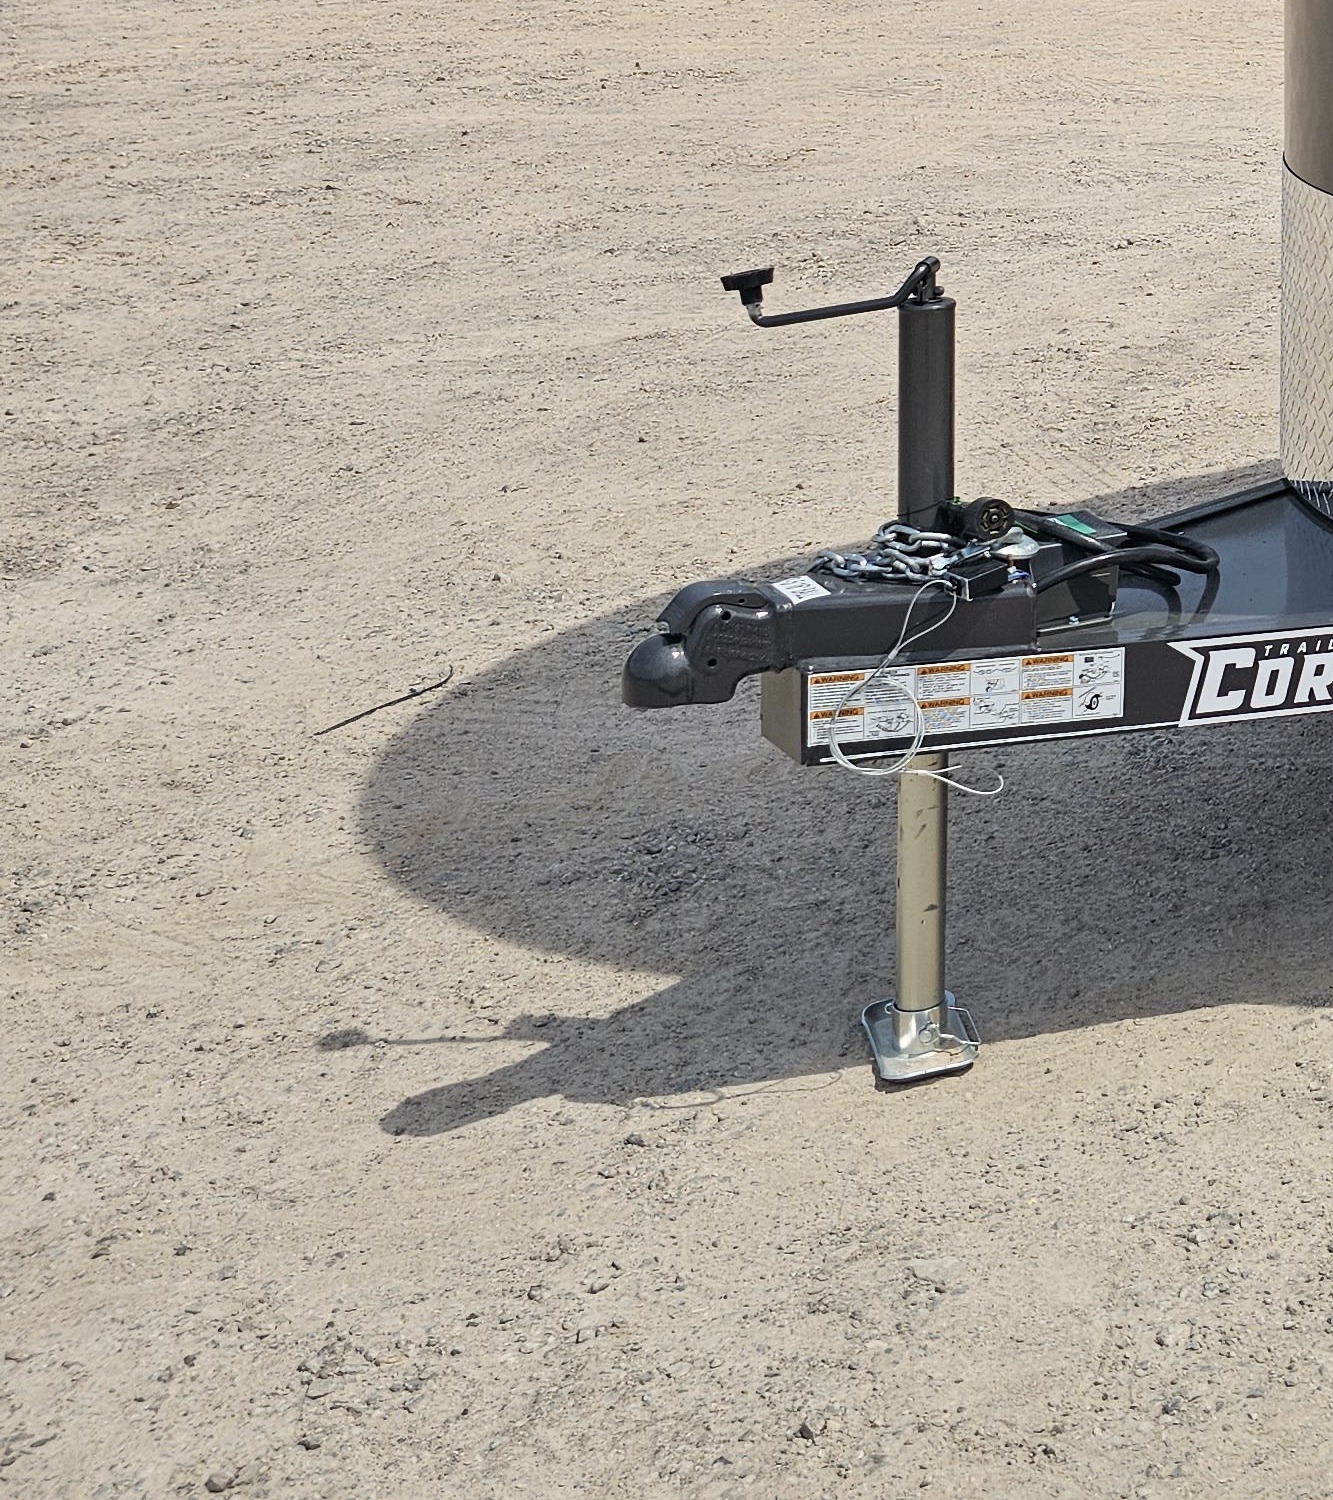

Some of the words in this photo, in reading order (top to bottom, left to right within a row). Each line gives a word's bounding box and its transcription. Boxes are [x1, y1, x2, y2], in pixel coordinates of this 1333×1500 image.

[1033, 655, 1069, 664] WARNING
[928, 664, 965, 673] WARNING
[821, 674, 859, 683] WARNING
[1032, 689, 1068, 697] WARNING
[928, 698, 965, 707] WARNING
